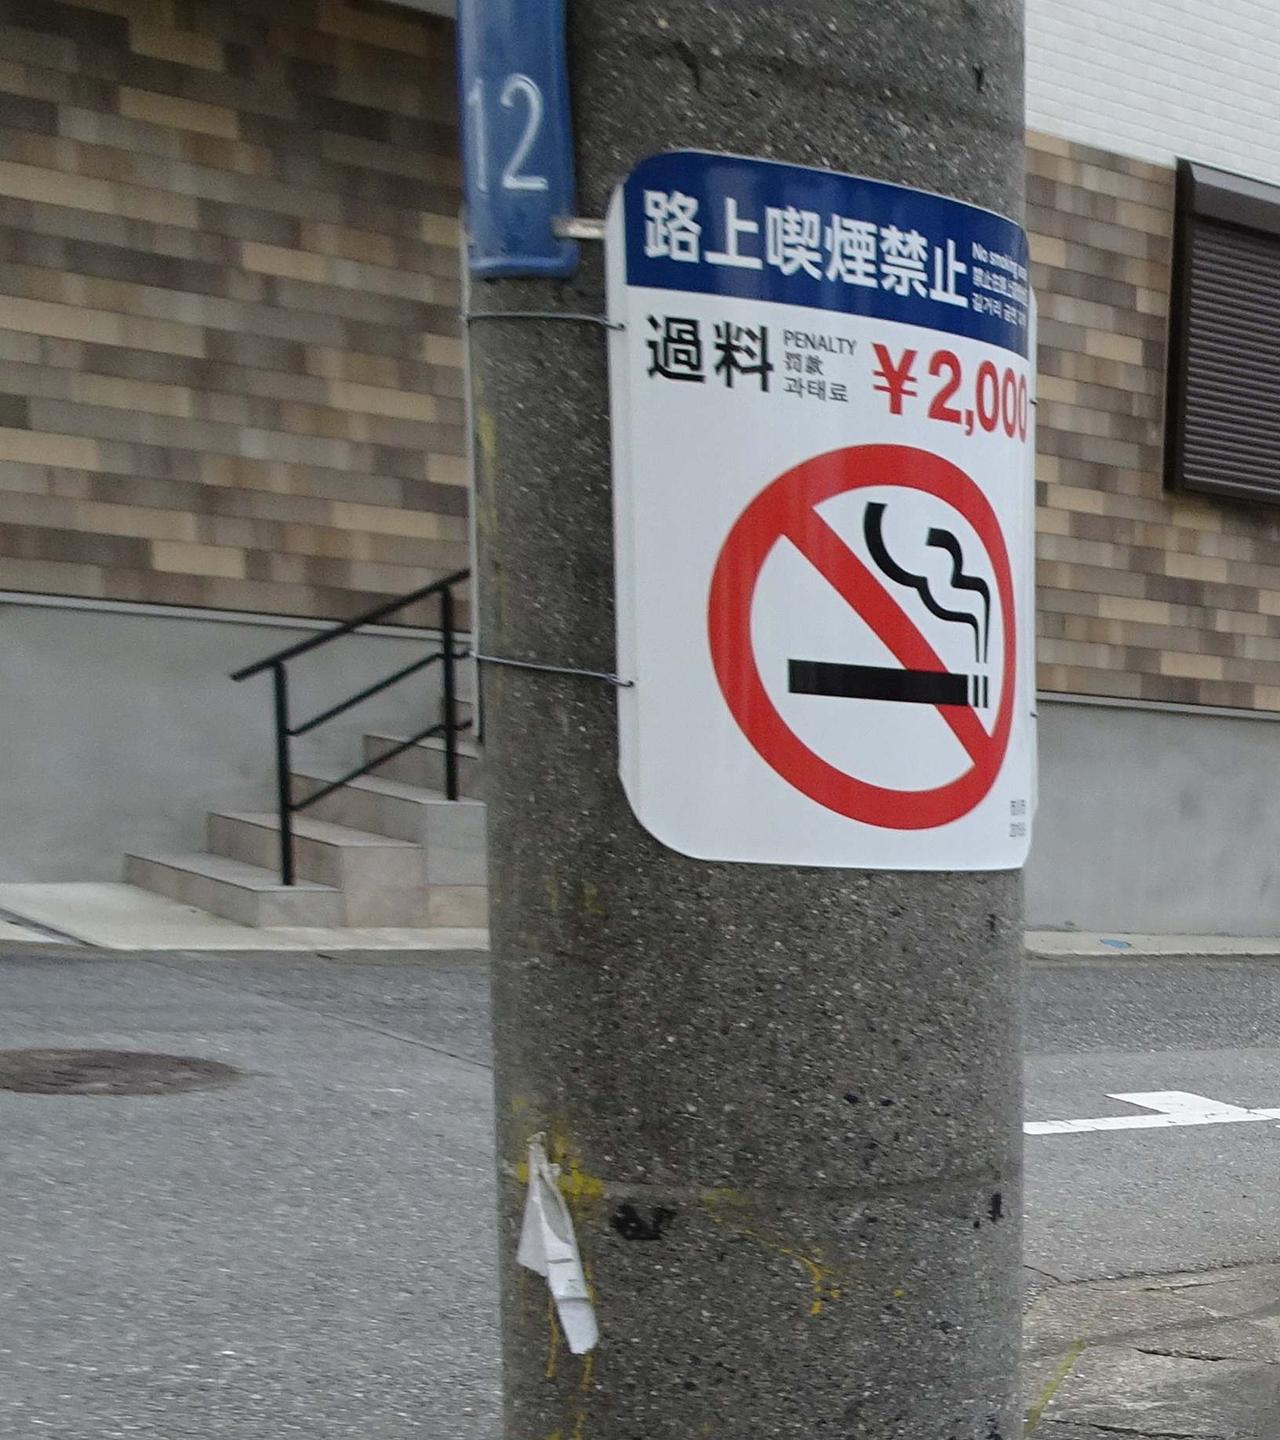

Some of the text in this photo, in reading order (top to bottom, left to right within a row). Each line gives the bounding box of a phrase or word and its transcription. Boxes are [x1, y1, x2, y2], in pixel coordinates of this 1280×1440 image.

[467, 73, 549, 194] 12
[643, 188, 968, 310] 路上喫煙禁止
[644, 315, 775, 392] 過料
[783, 328, 857, 356] PENALTY
[782, 376, 849, 403] 과태료
